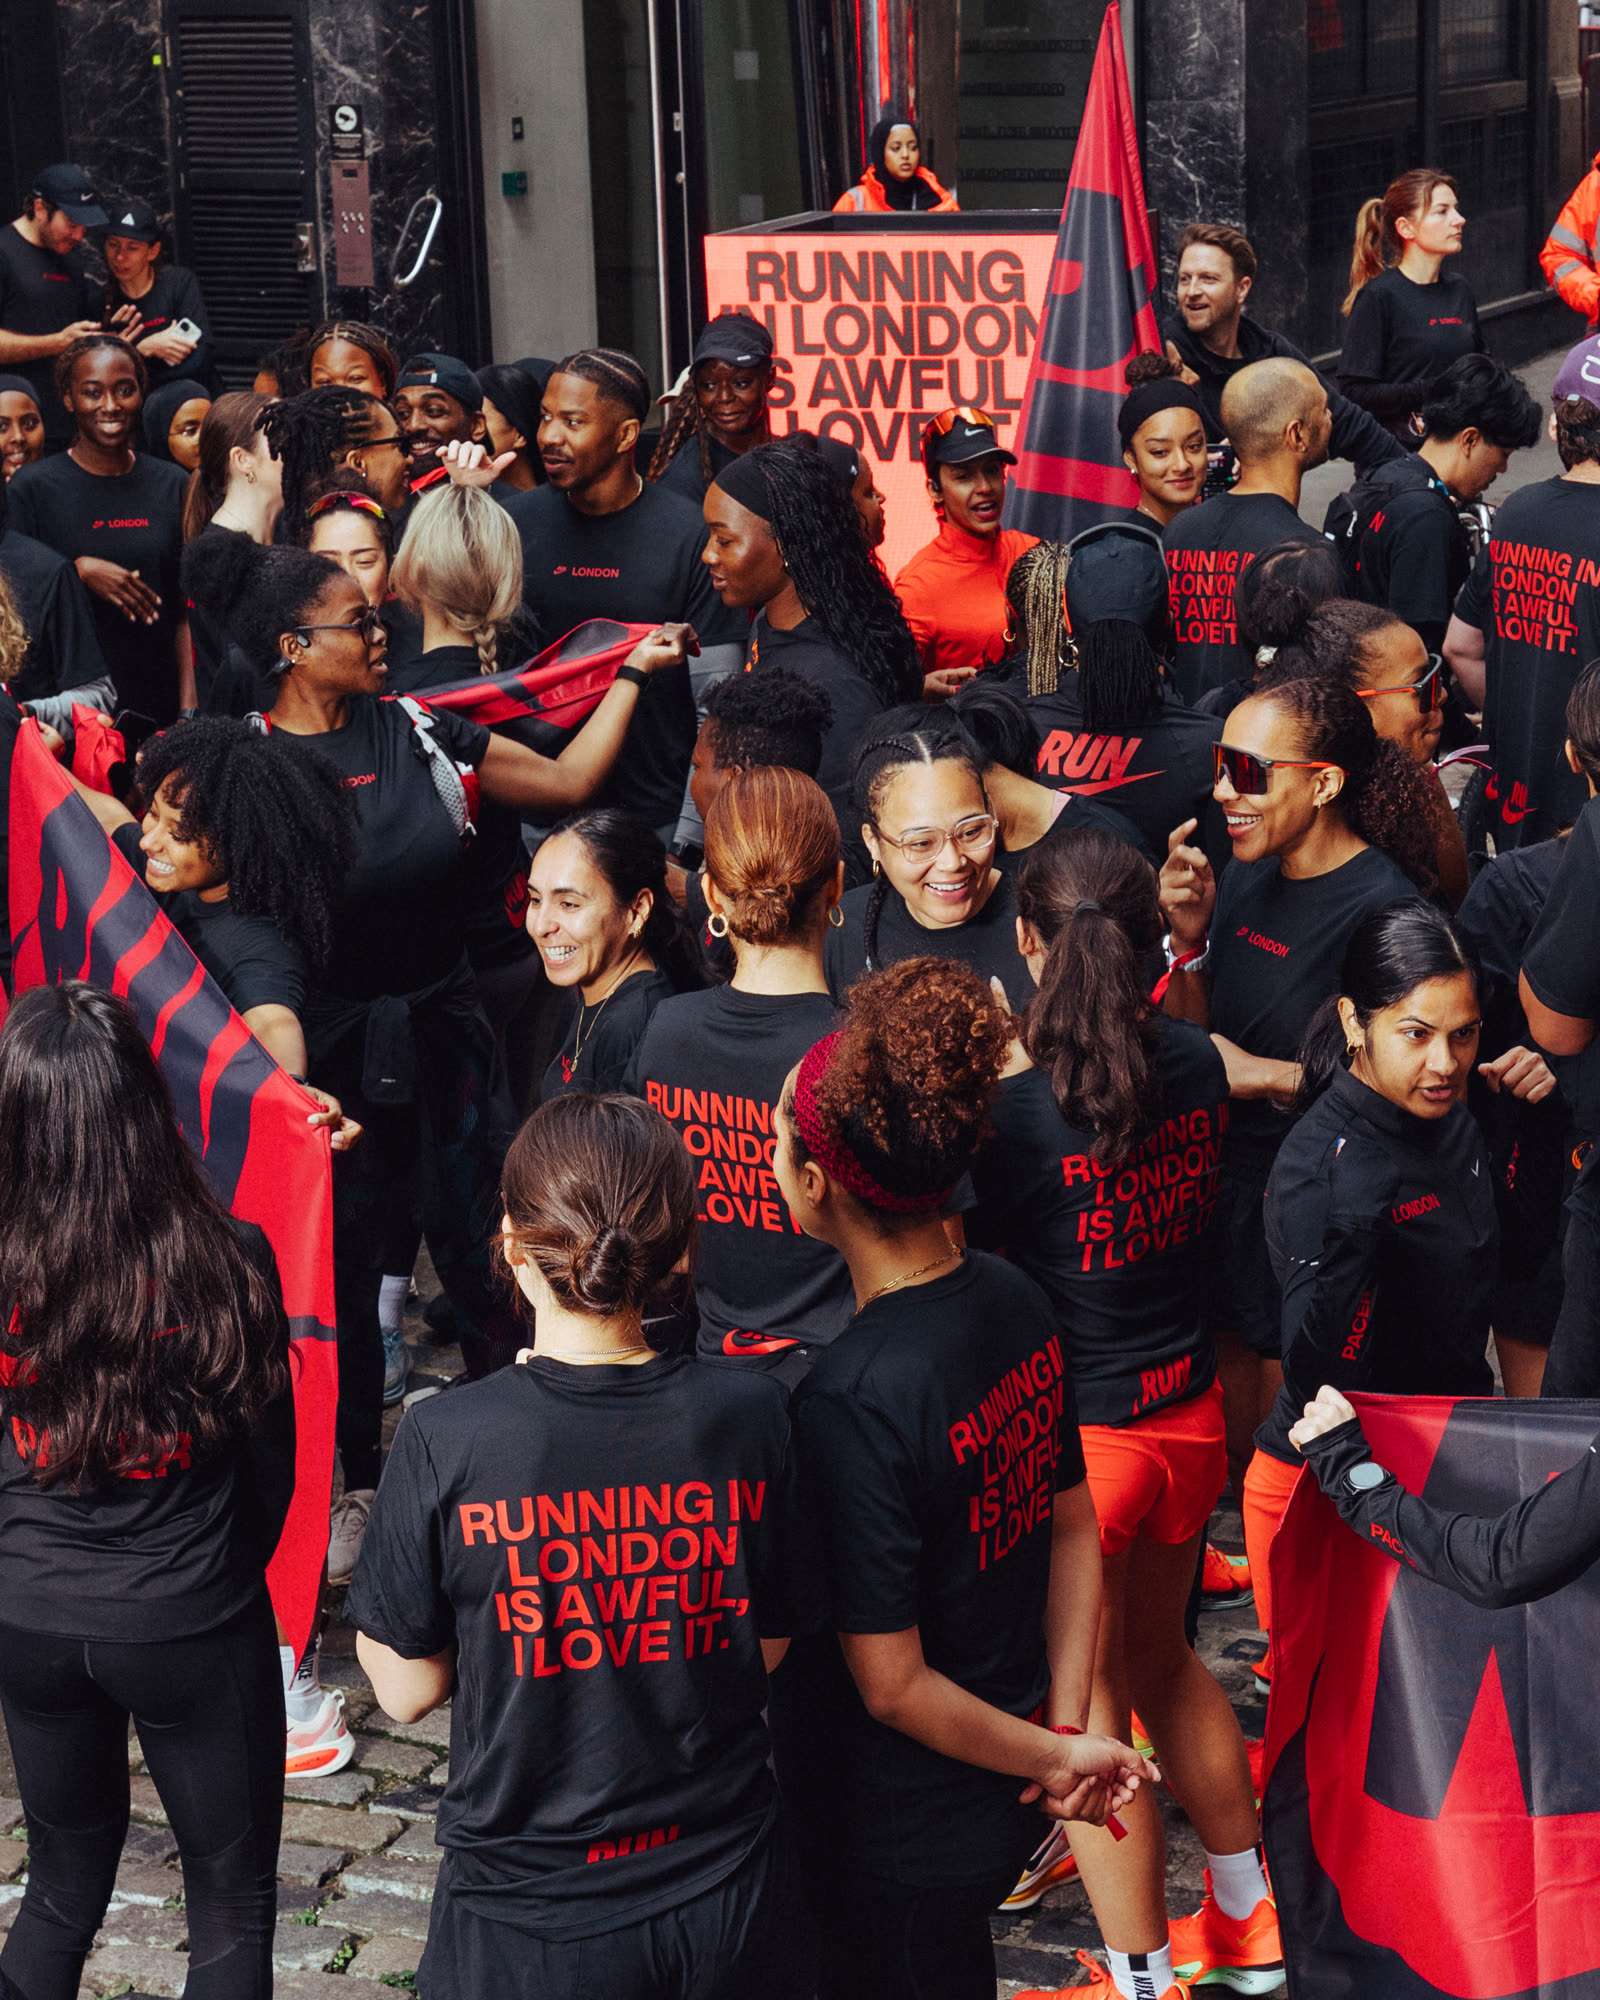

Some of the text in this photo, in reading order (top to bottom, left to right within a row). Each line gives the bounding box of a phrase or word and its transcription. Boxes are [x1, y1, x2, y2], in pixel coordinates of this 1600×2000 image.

[746, 250, 1025, 303] RUNNING
[108, 518, 149, 529] LONDON
[571, 566, 620, 578] LONDON
[1489, 539, 1573, 578] RUNNING
[1494, 564, 1578, 606] LONDON
[1036, 729, 1143, 782] RUN
[1248, 931, 1290, 958] LONDON
[646, 1080, 778, 1135] RUNNIN
[1096, 1137, 1223, 1208] LONDON
[1077, 1209, 1115, 1243] IS
[1392, 1193, 1441, 1224] LONDON
[1082, 1243, 1094, 1272] I
[1104, 1214, 1192, 1270] LOVE
[1341, 1291, 1372, 1361] PACER
[1140, 1354, 1192, 1407] RUN
[948, 1351, 1054, 1466] RUNNING
[984, 1380, 1064, 1488] LONDON
[458, 1479, 766, 1547] RUNNING IN
[969, 1487, 1001, 1533] IS
[979, 1480, 1051, 1572] I LOVE
[507, 1525, 738, 1587] LONDON
[494, 1569, 750, 1633] IS AWFUL,
[513, 1611, 730, 1679] I LOVE IT.
